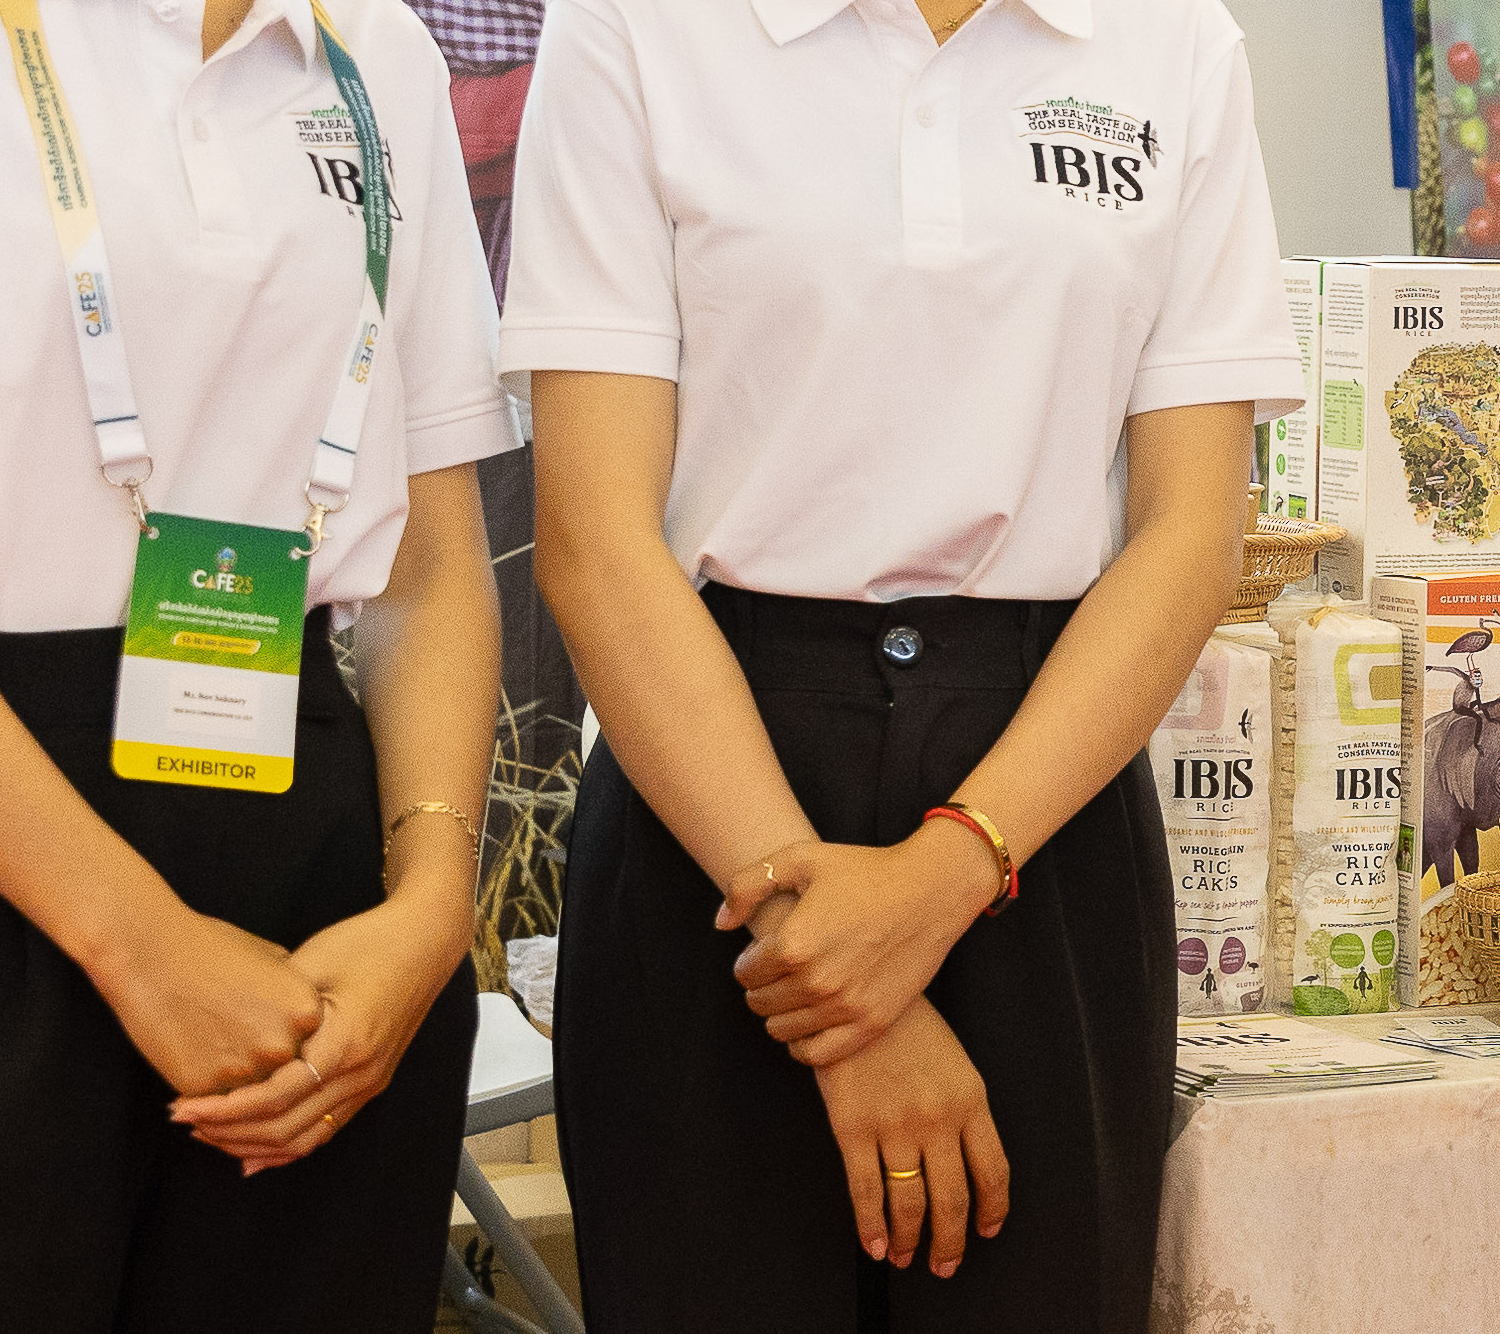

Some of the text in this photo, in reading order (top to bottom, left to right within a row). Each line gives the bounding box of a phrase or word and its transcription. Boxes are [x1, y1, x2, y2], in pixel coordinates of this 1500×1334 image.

[296, 119, 352, 131] THE REAL
[1025, 108, 1139, 133] THE REAL TASTE OF
[1028, 119, 1137, 144] CONSERVATION
[299, 130, 361, 144] CONSER
[1030, 142, 1144, 202] IBIS
[1065, 187, 1124, 211] RICE
[1393, 306, 1444, 330] IBIS
[1440, 594, 1478, 604] GLUTEN
[1337, 741, 1392, 751] THE REAL TASTE
[156, 755, 257, 780] EXHIBITOR
[1173, 758, 1254, 800] IBIS
[1335, 767, 1401, 801] IBIS
[1352, 801, 1391, 810] RICE
[1332, 842, 1394, 852] WHOLEGR
